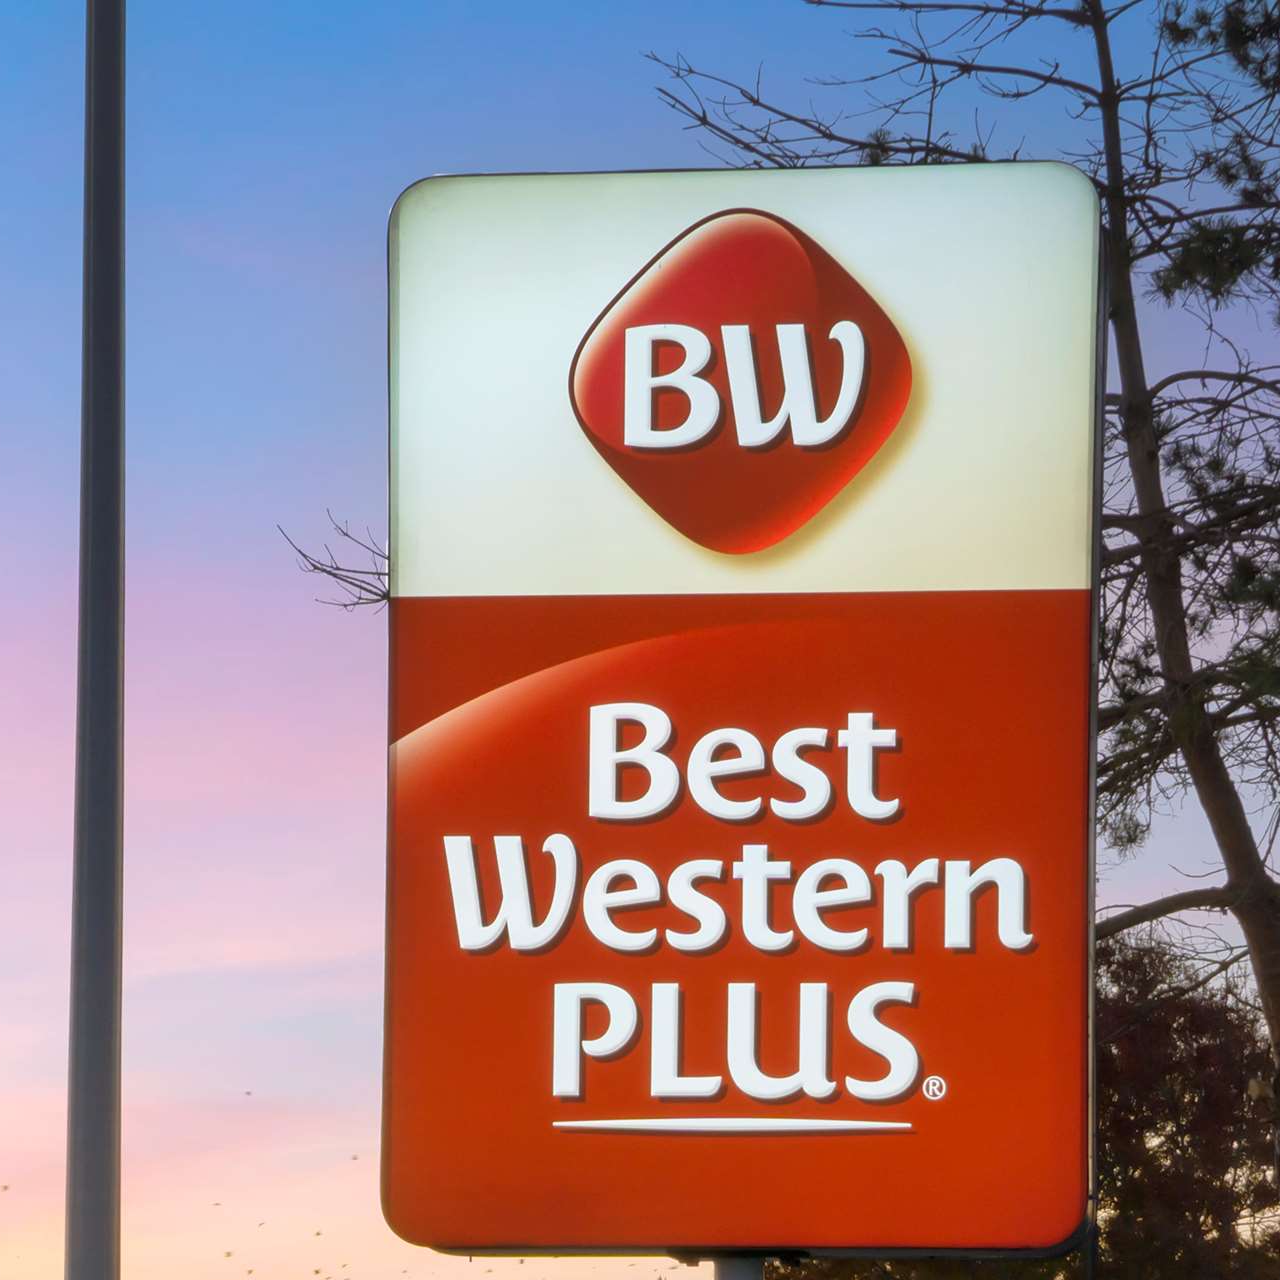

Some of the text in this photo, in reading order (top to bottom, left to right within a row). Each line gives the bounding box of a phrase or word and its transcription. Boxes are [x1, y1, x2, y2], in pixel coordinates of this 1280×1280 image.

[623, 319, 866, 448] BW
[588, 701, 900, 820] Best
[443, 832, 1034, 952] Western
